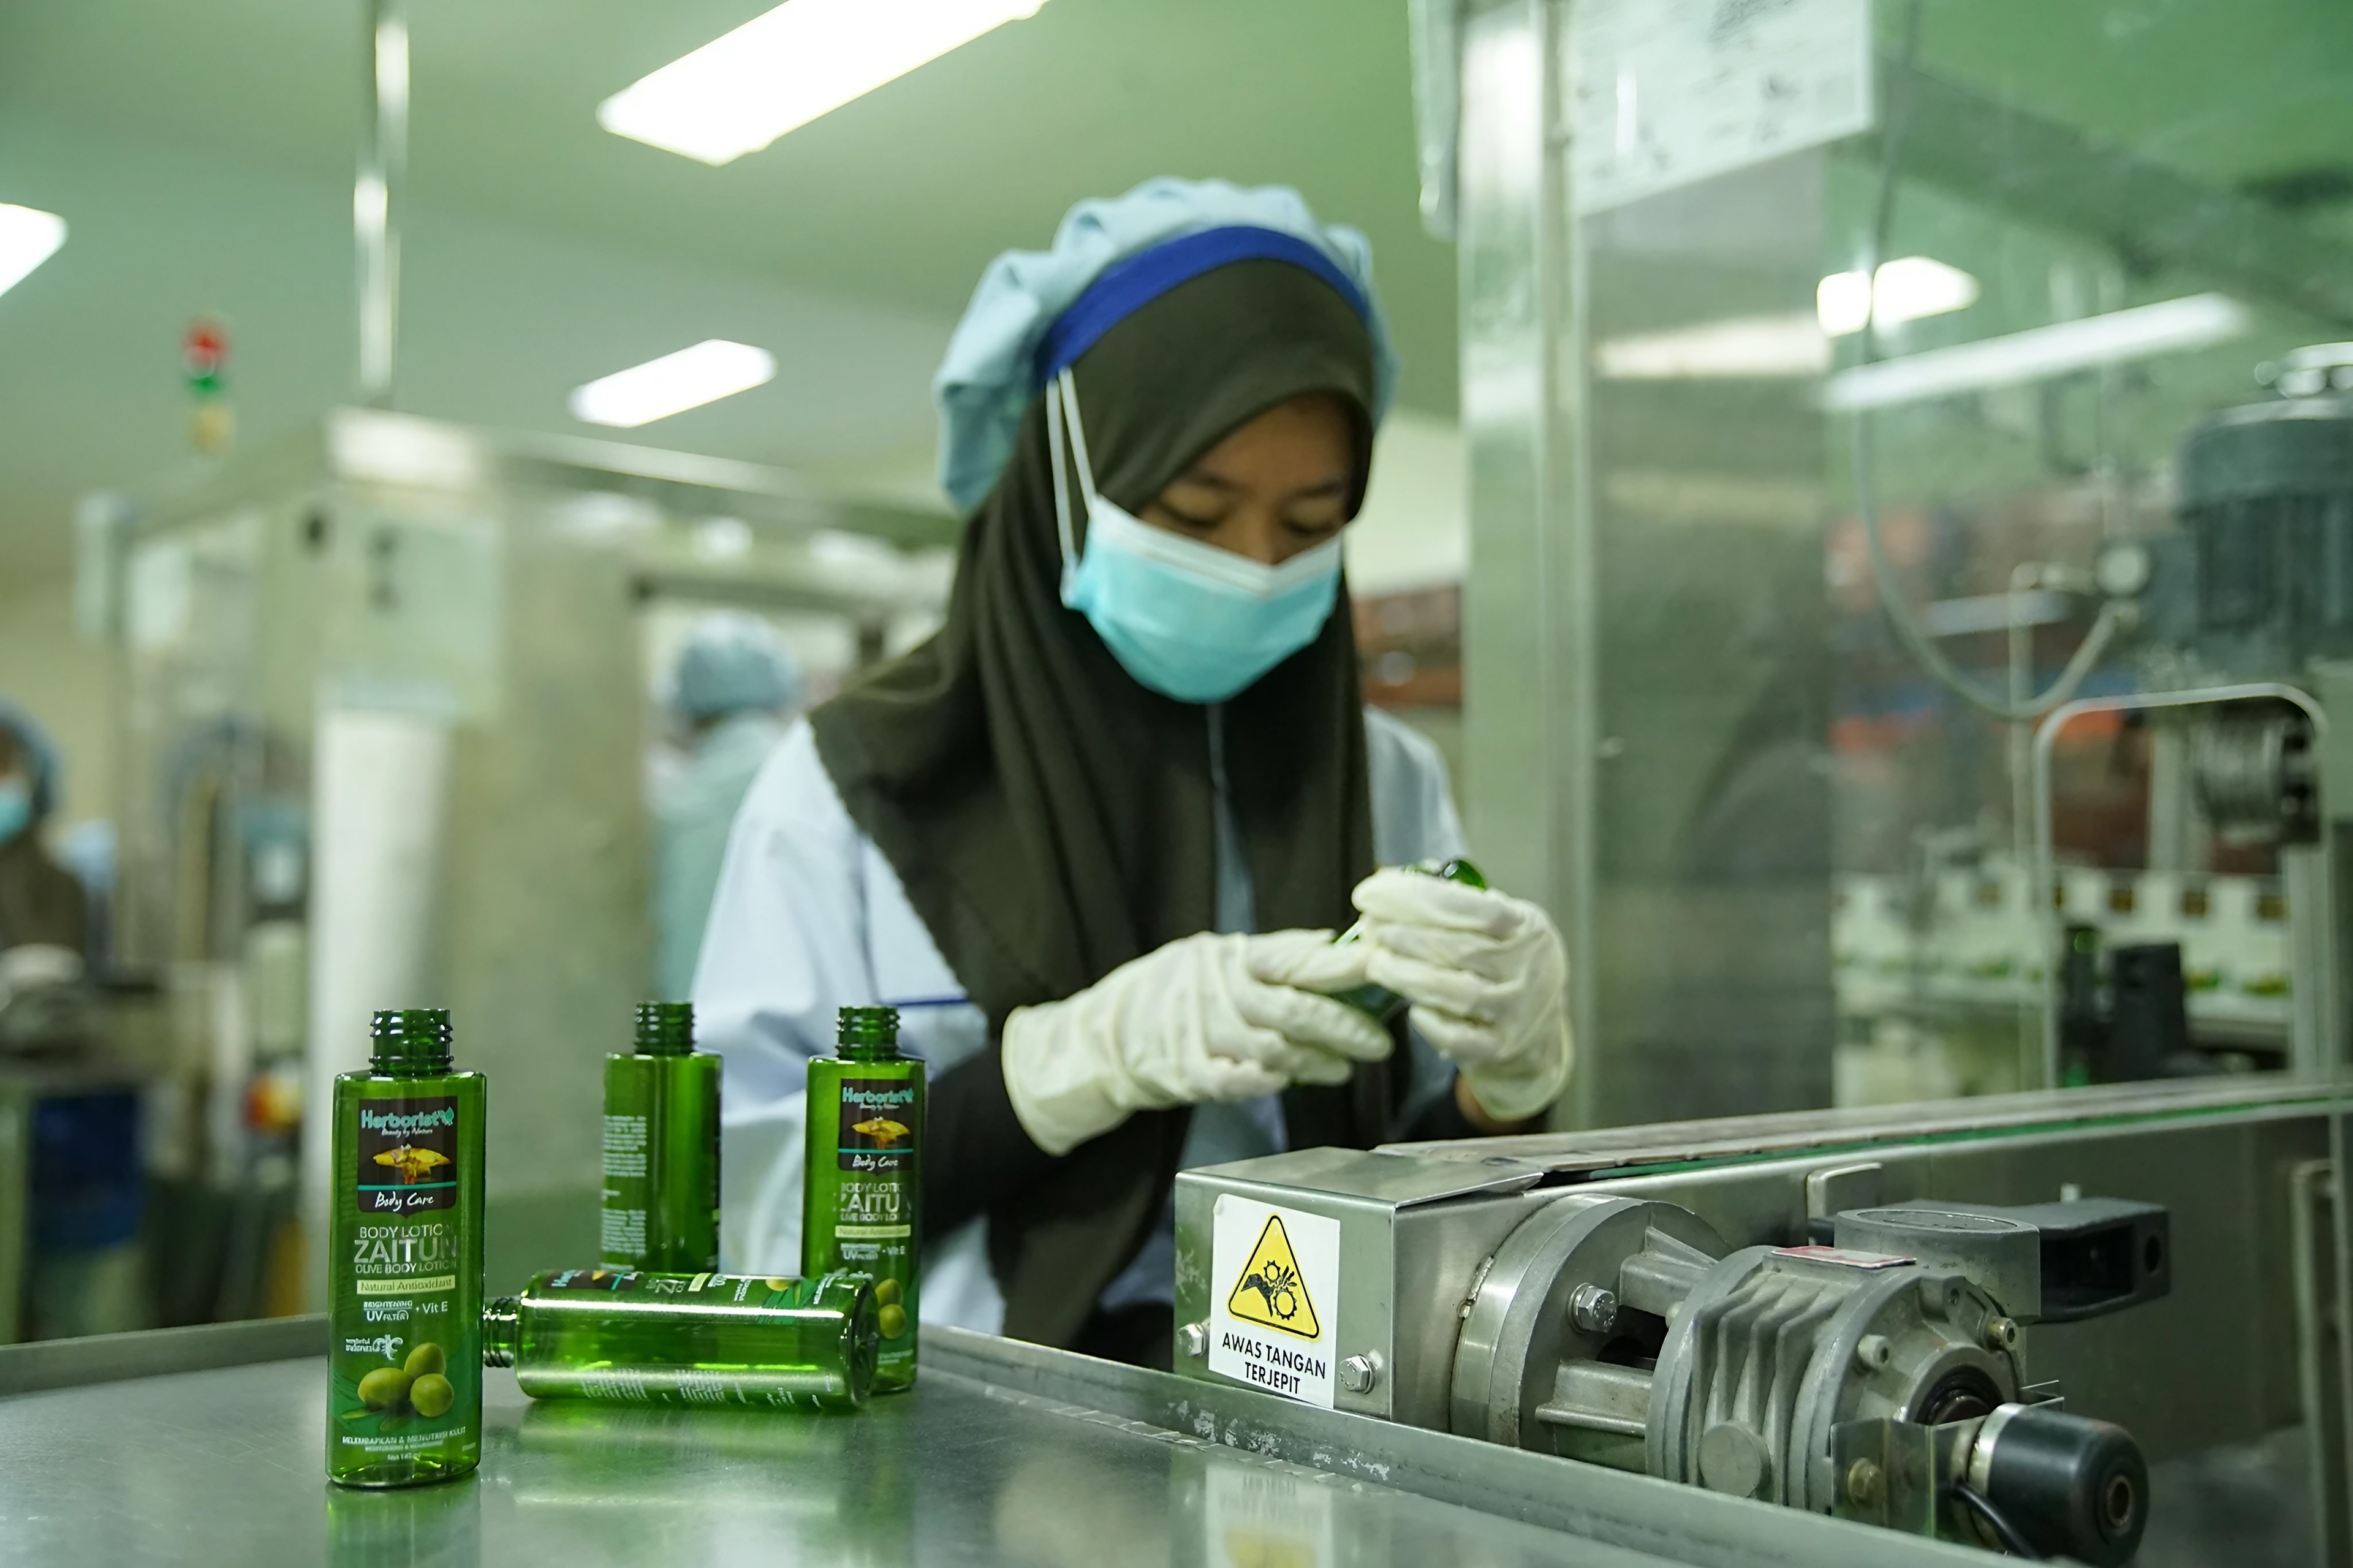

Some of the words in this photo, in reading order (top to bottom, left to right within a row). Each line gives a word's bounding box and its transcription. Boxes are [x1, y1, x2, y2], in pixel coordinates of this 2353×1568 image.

[361, 1109, 439, 1129] Herborist
[374, 1191, 403, 1211] Body
[407, 1192, 434, 1206] Care
[360, 1226, 398, 1239] BODY
[354, 1235, 457, 1263] ZAITUN
[355, 1263, 382, 1274] OLIVE
[385, 1262, 417, 1274] BODY
[361, 1281, 395, 1292] Natural
[422, 1303, 439, 1314] Vit
[441, 1301, 449, 1312] E
[366, 1311, 383, 1322] UV
[1222, 1332, 1262, 1359] AWAS
[1266, 1344, 1326, 1379] TANGAN
[1245, 1362, 1300, 1395] TERJEPIT
